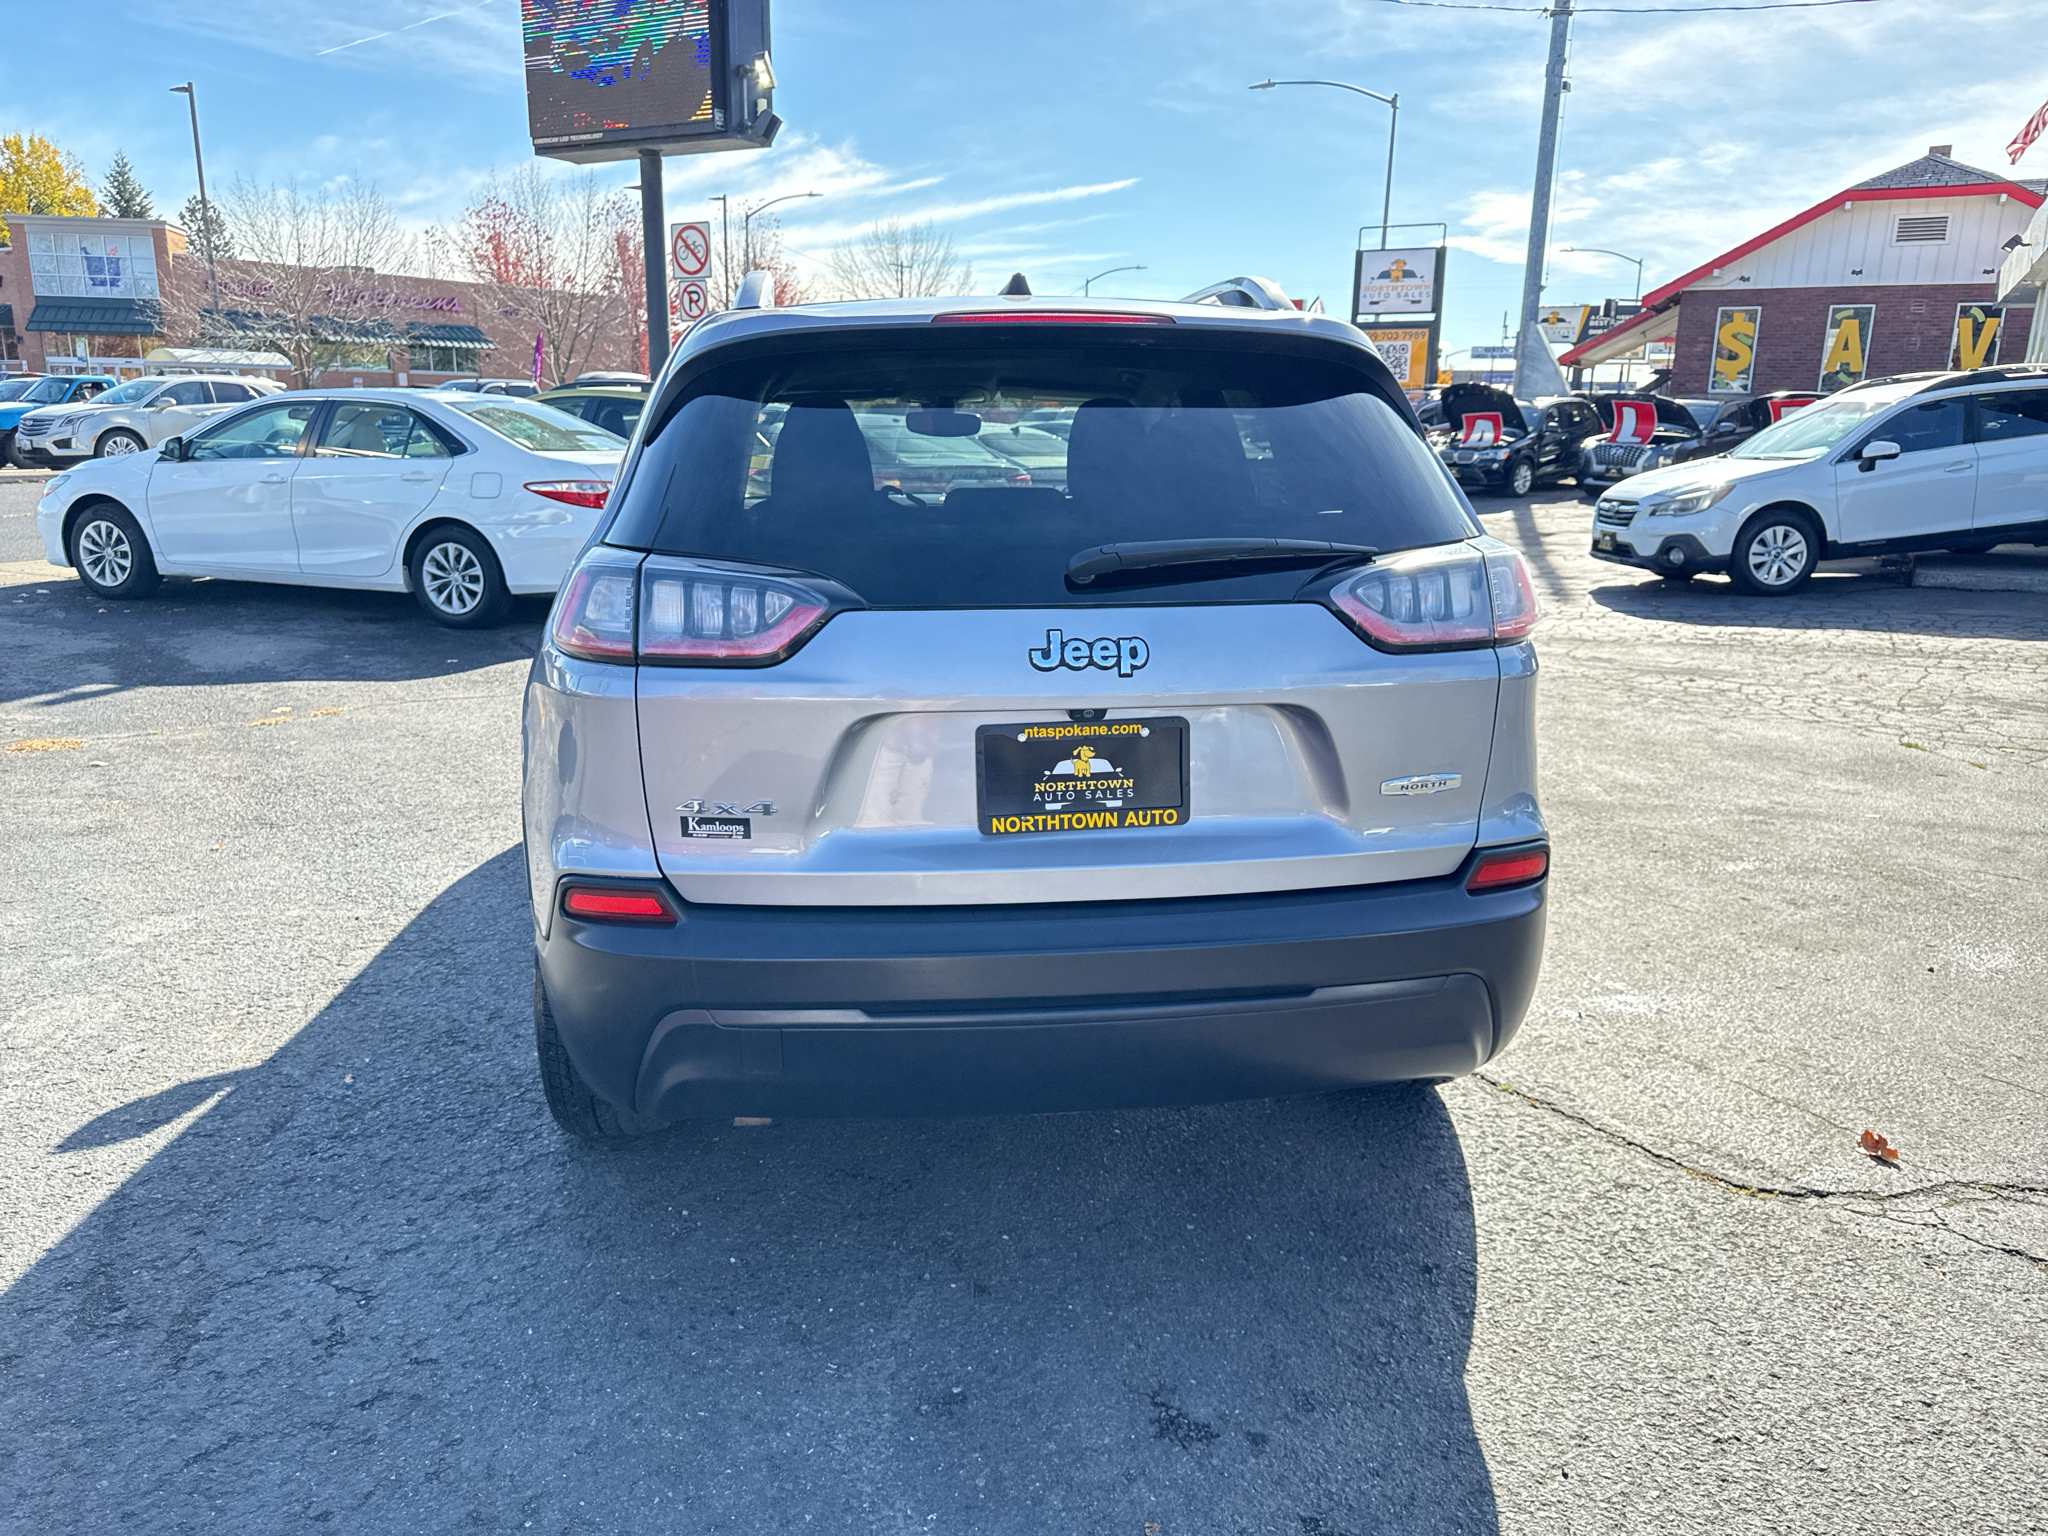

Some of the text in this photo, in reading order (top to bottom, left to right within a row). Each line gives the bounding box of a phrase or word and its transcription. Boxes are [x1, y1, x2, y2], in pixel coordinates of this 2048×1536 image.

[570, 132, 603, 141] TECHNOLOGY
[1363, 284, 1431, 293] NORTHTOWN
[1396, 291, 1431, 299] SALES
[1028, 629, 1149, 678] Jeep
[1024, 724, 1142, 739] ntaspokane.com
[1034, 779, 1134, 792] NORTHTOWN
[1400, 780, 1447, 791] NORTH
[1033, 788, 1134, 802] AUTO SALES
[687, 816, 745, 835] Kamloops
[992, 809, 1178, 834] NORTHTOWN AUTO
